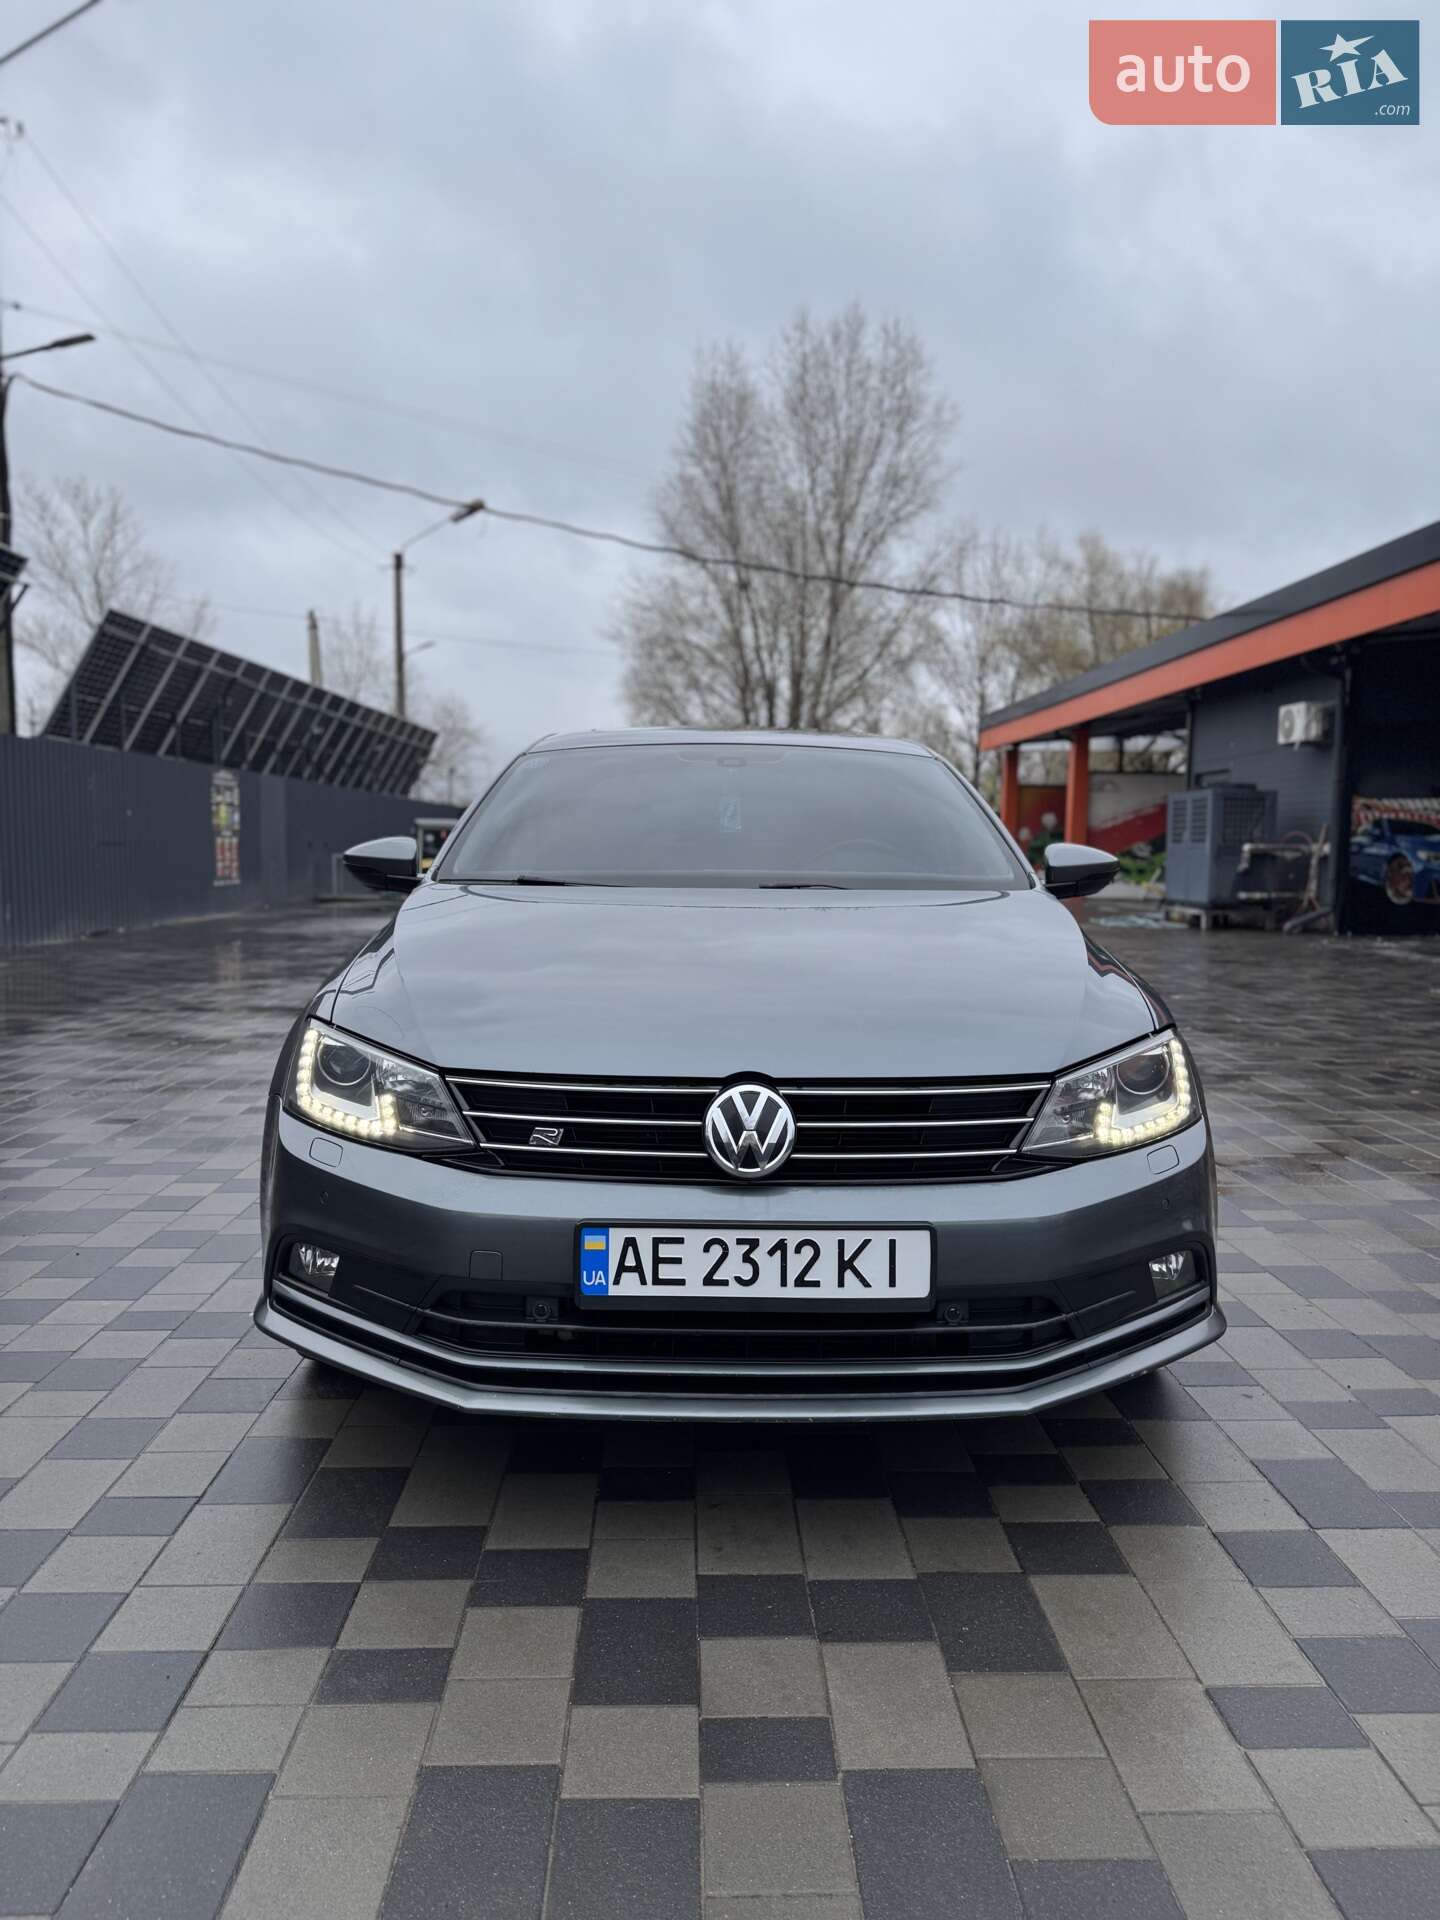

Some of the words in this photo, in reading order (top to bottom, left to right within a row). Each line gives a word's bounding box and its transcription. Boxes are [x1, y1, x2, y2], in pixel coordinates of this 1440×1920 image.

[583, 1270, 607, 1286] UA
[612, 1236, 687, 1286] AE
[702, 1237, 821, 1288] 2312
[837, 1238, 897, 1288] KI
